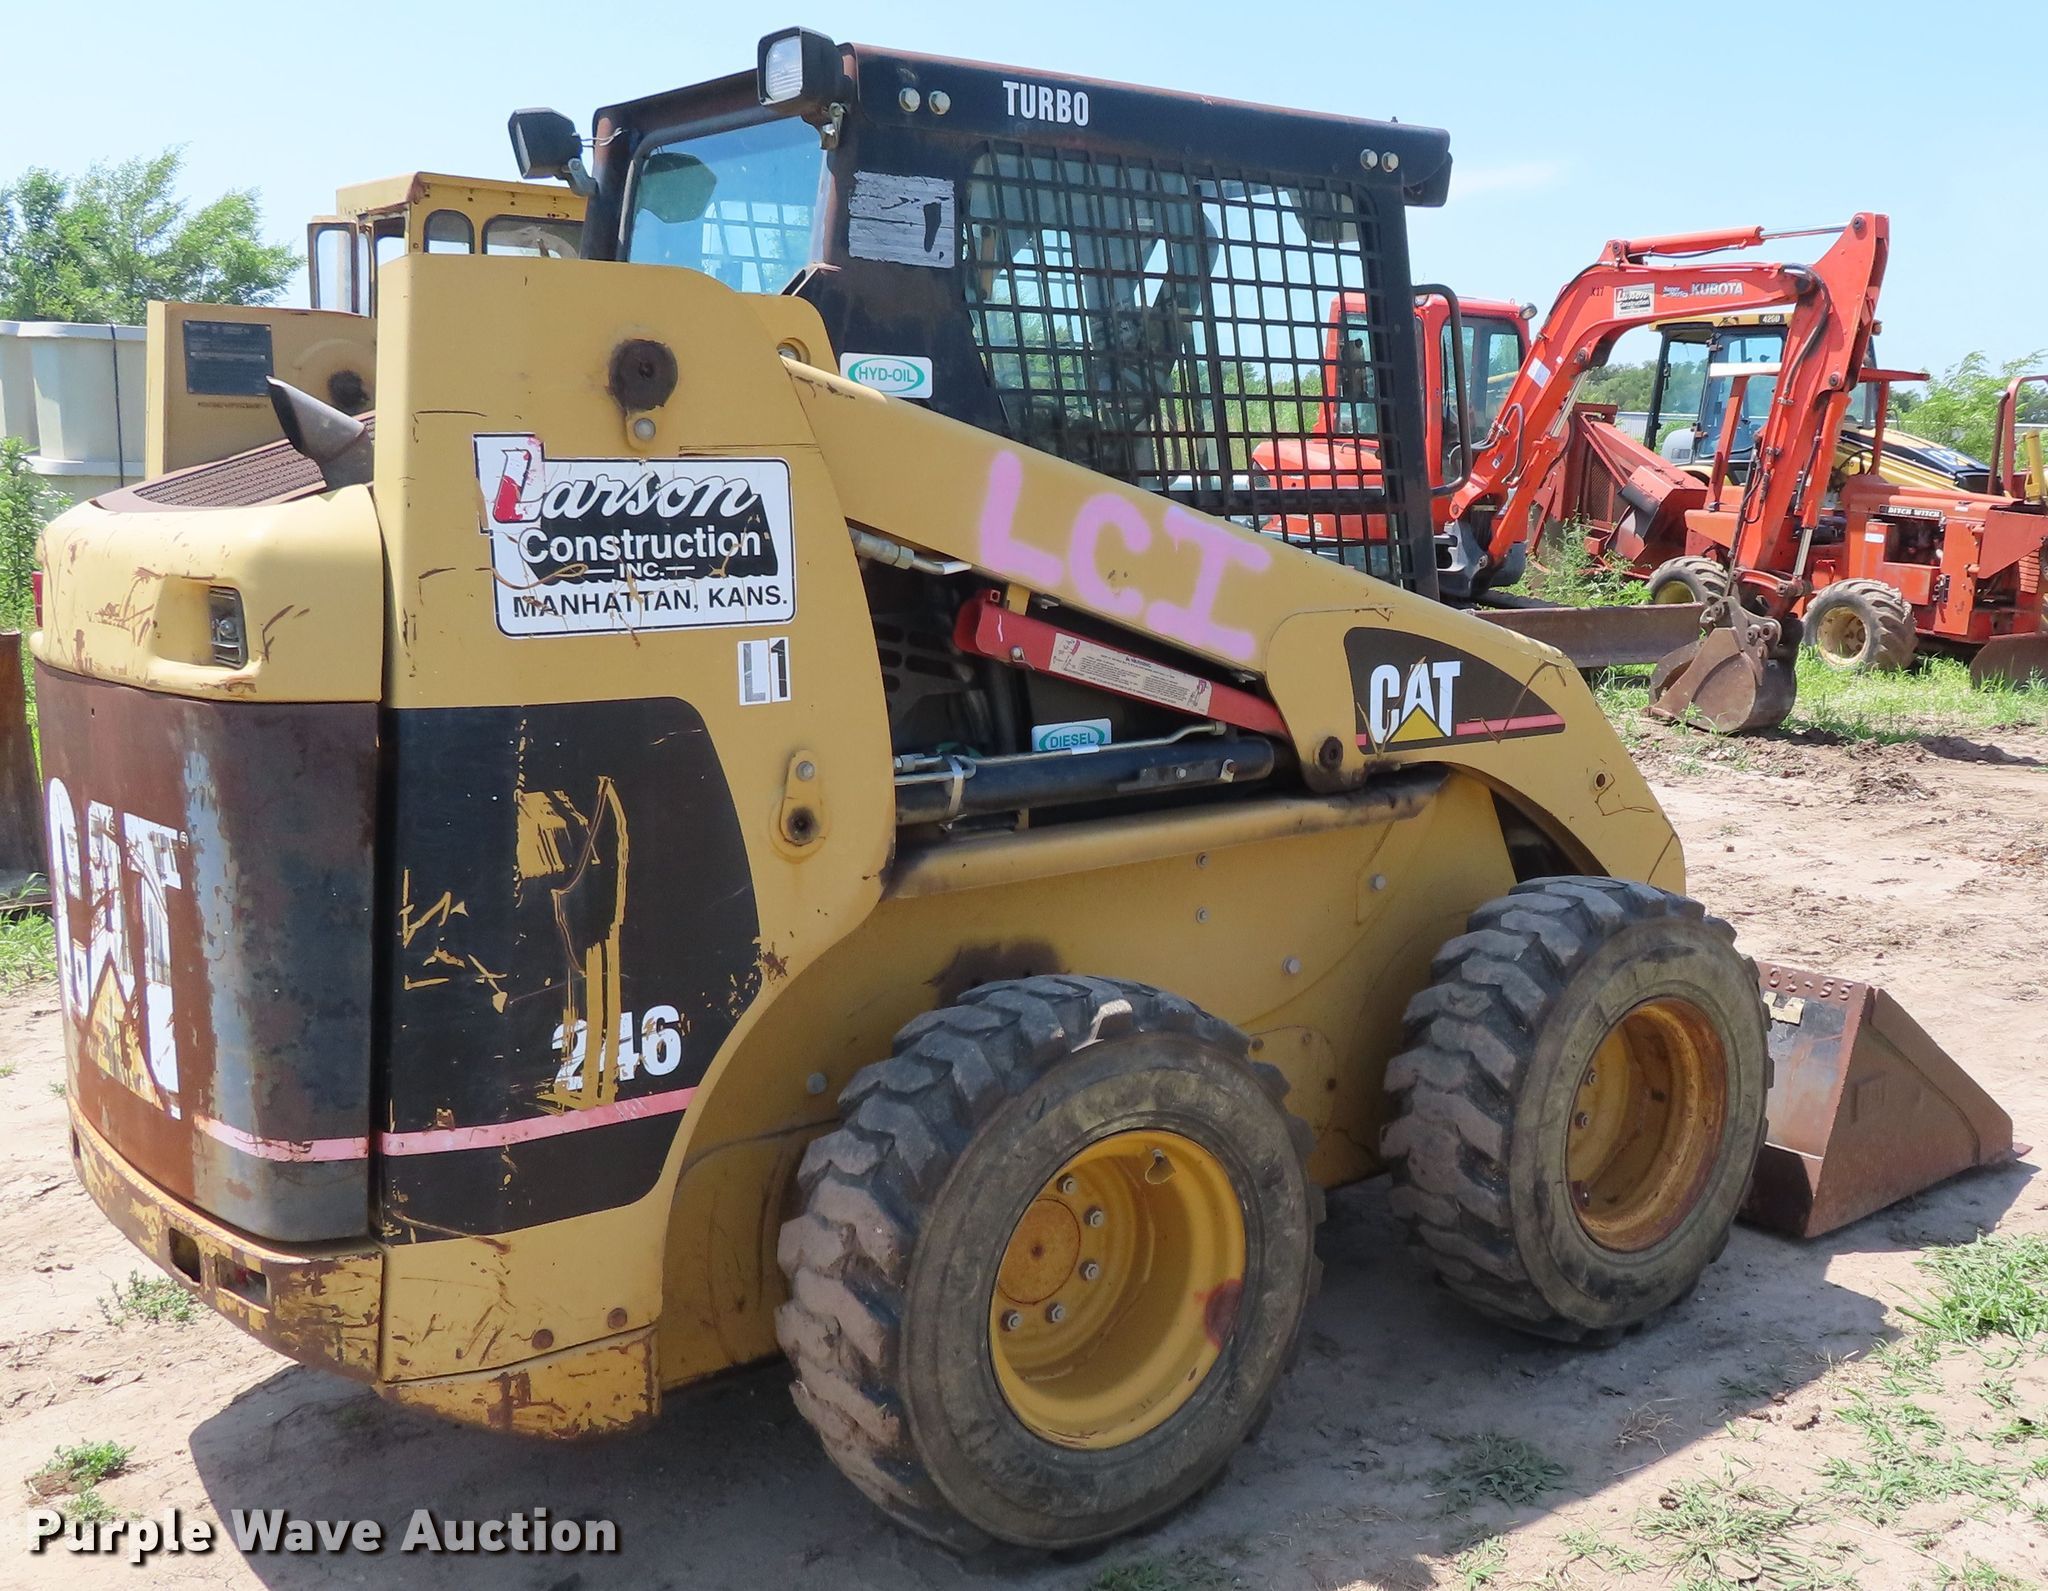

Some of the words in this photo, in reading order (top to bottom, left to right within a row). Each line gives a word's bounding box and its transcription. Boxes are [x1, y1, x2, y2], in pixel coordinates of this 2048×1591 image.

[1003, 80, 1089, 127] TURBO
[1691, 281, 1744, 297] KUBOTA
[858, 366, 915, 383] HYD-OIL
[493, 449, 760, 524] Larson
[1887, 506, 1912, 515] DITCH
[1913, 508, 1940, 517] WITCH
[518, 525, 762, 564] Construction
[977, 450, 1272, 662] LCI
[619, 562, 666, 578] INC.
[512, 588, 700, 619] MANHATTAN,
[708, 584, 789, 609] KANS.
[1369, 660, 1461, 744] CAT
[1050, 732, 1095, 749] DIESEL
[47, 776, 184, 1094] CAT
